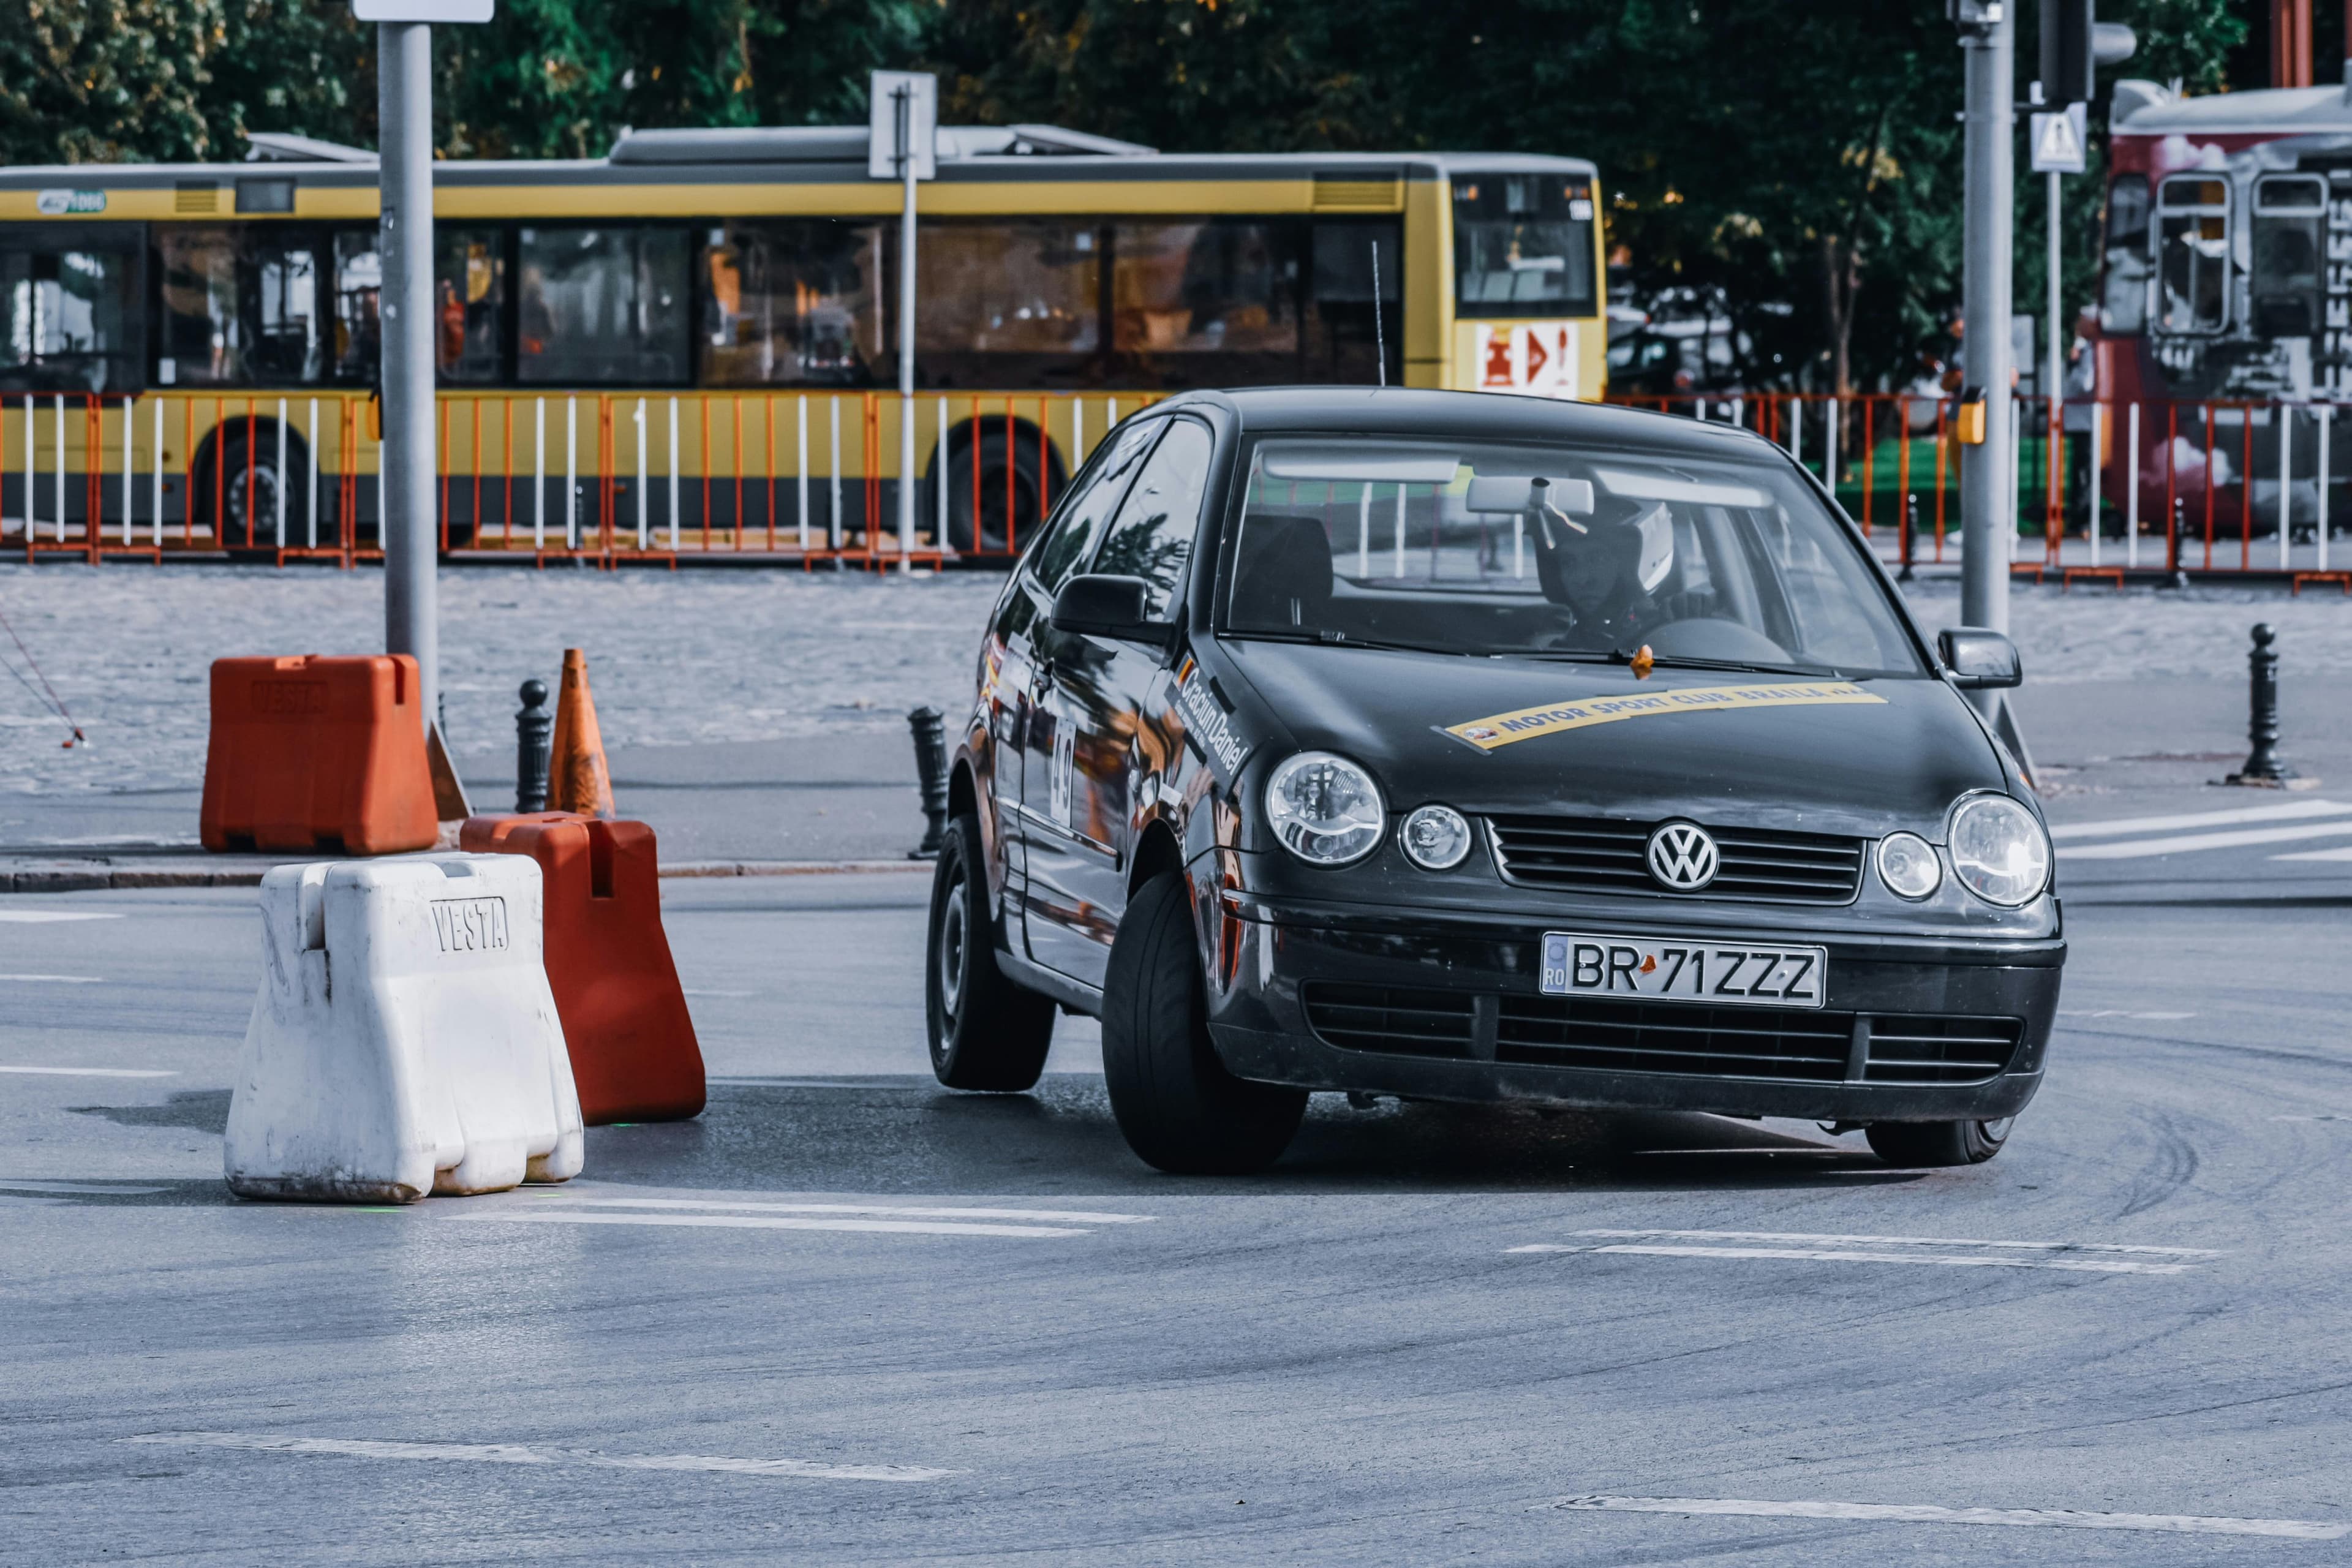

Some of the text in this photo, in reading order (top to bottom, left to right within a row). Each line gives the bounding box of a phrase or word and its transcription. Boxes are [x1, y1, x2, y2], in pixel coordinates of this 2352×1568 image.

[1182, 668, 1217, 734] Craciun
[1208, 713, 1248, 775] Daniel
[1499, 708, 1593, 732] MOTOR
[1591, 698, 1670, 714] SPORT
[1671, 693, 1734, 704] CLUB
[1734, 688, 1831, 699] BRAILA
[1053, 734, 1072, 809] 49
[432, 902, 503, 951] VESTA
[1545, 968, 1564, 986] RO
[1572, 943, 1815, 998] BR 71 ZZZ
